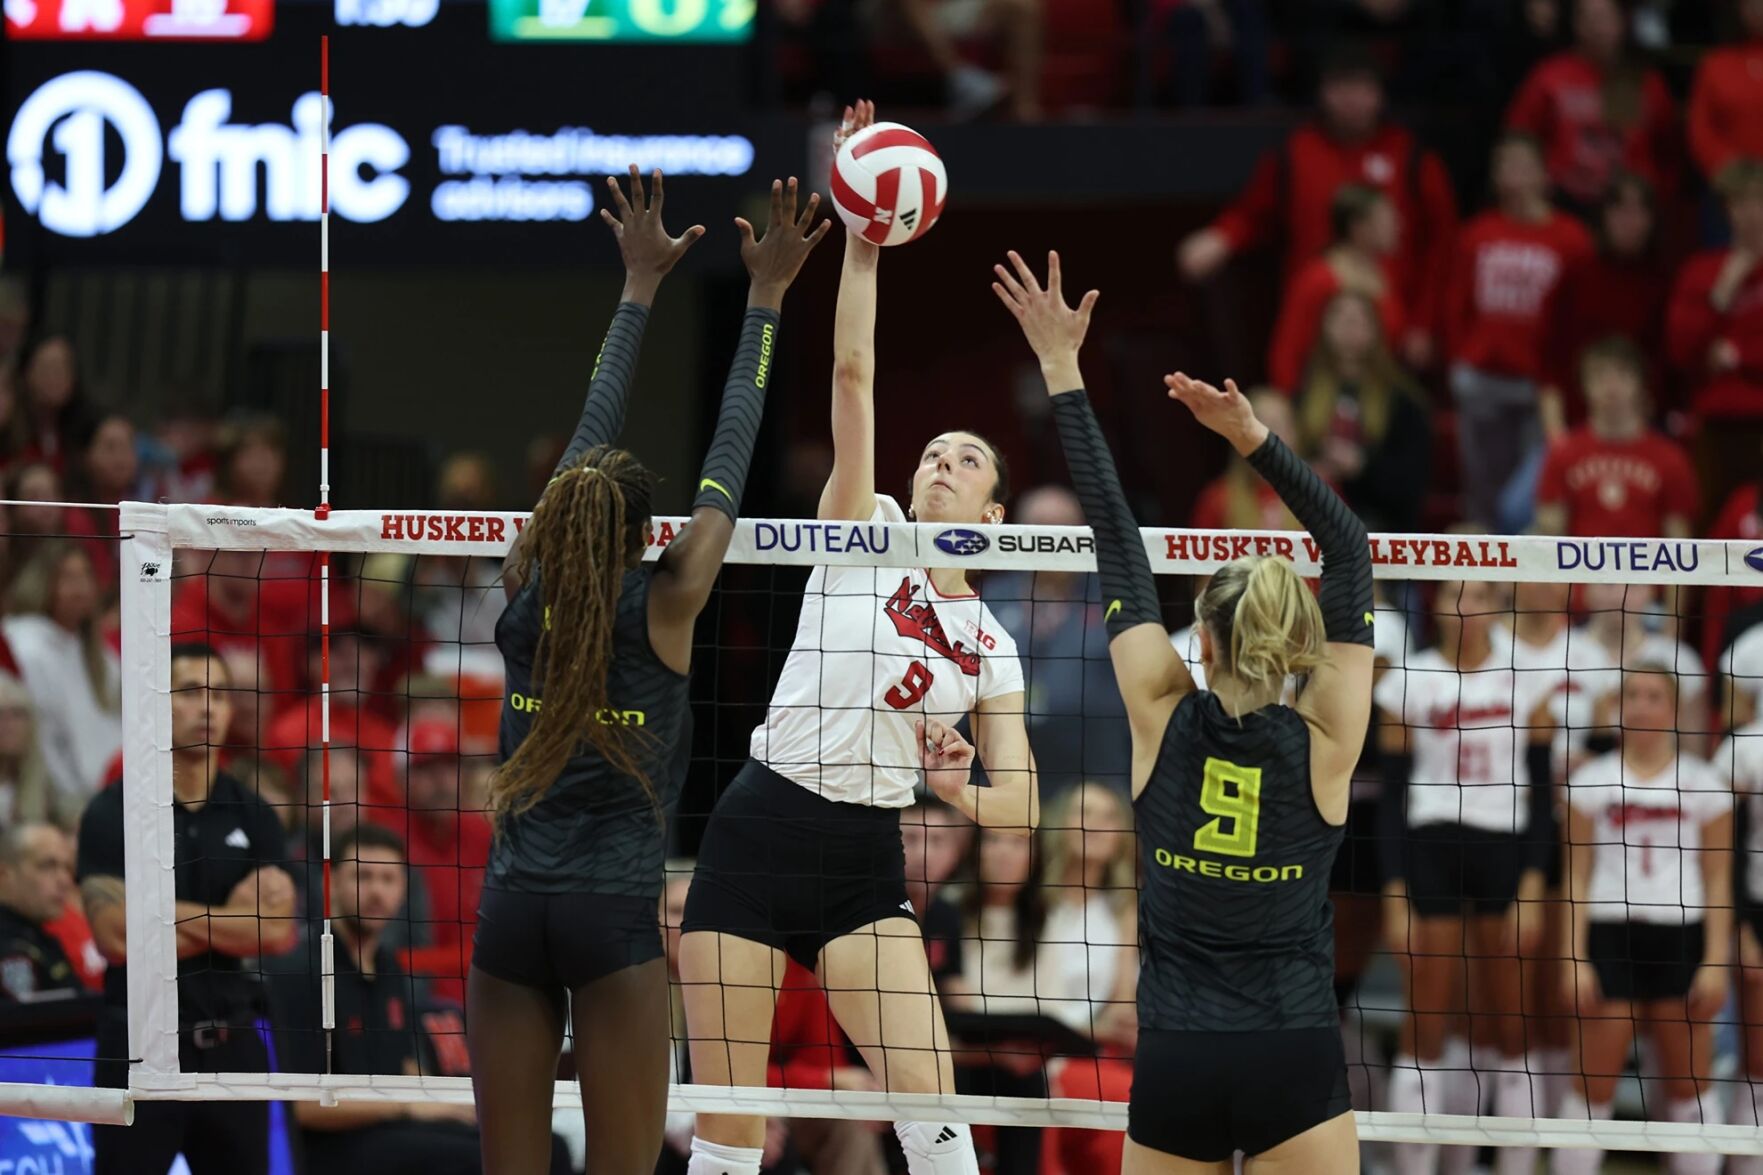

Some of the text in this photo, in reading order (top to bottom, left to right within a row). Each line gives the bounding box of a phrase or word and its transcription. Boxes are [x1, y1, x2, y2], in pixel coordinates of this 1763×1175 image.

[168, 88, 410, 222] fnic
[755, 323, 774, 389] OREGON
[206, 517, 257, 527] sports imports
[380, 514, 505, 542] HUSKER
[754, 522, 889, 554] DUTEAU
[998, 534, 1095, 554] SUBAR
[1165, 535, 1295, 562] HUSKER
[1302, 537, 1517, 568] VLEYBALL
[1557, 541, 1699, 571] DUTEAU
[884, 660, 934, 710] 9
[1193, 756, 1263, 858] 9
[1155, 848, 1303, 882] OREGON
